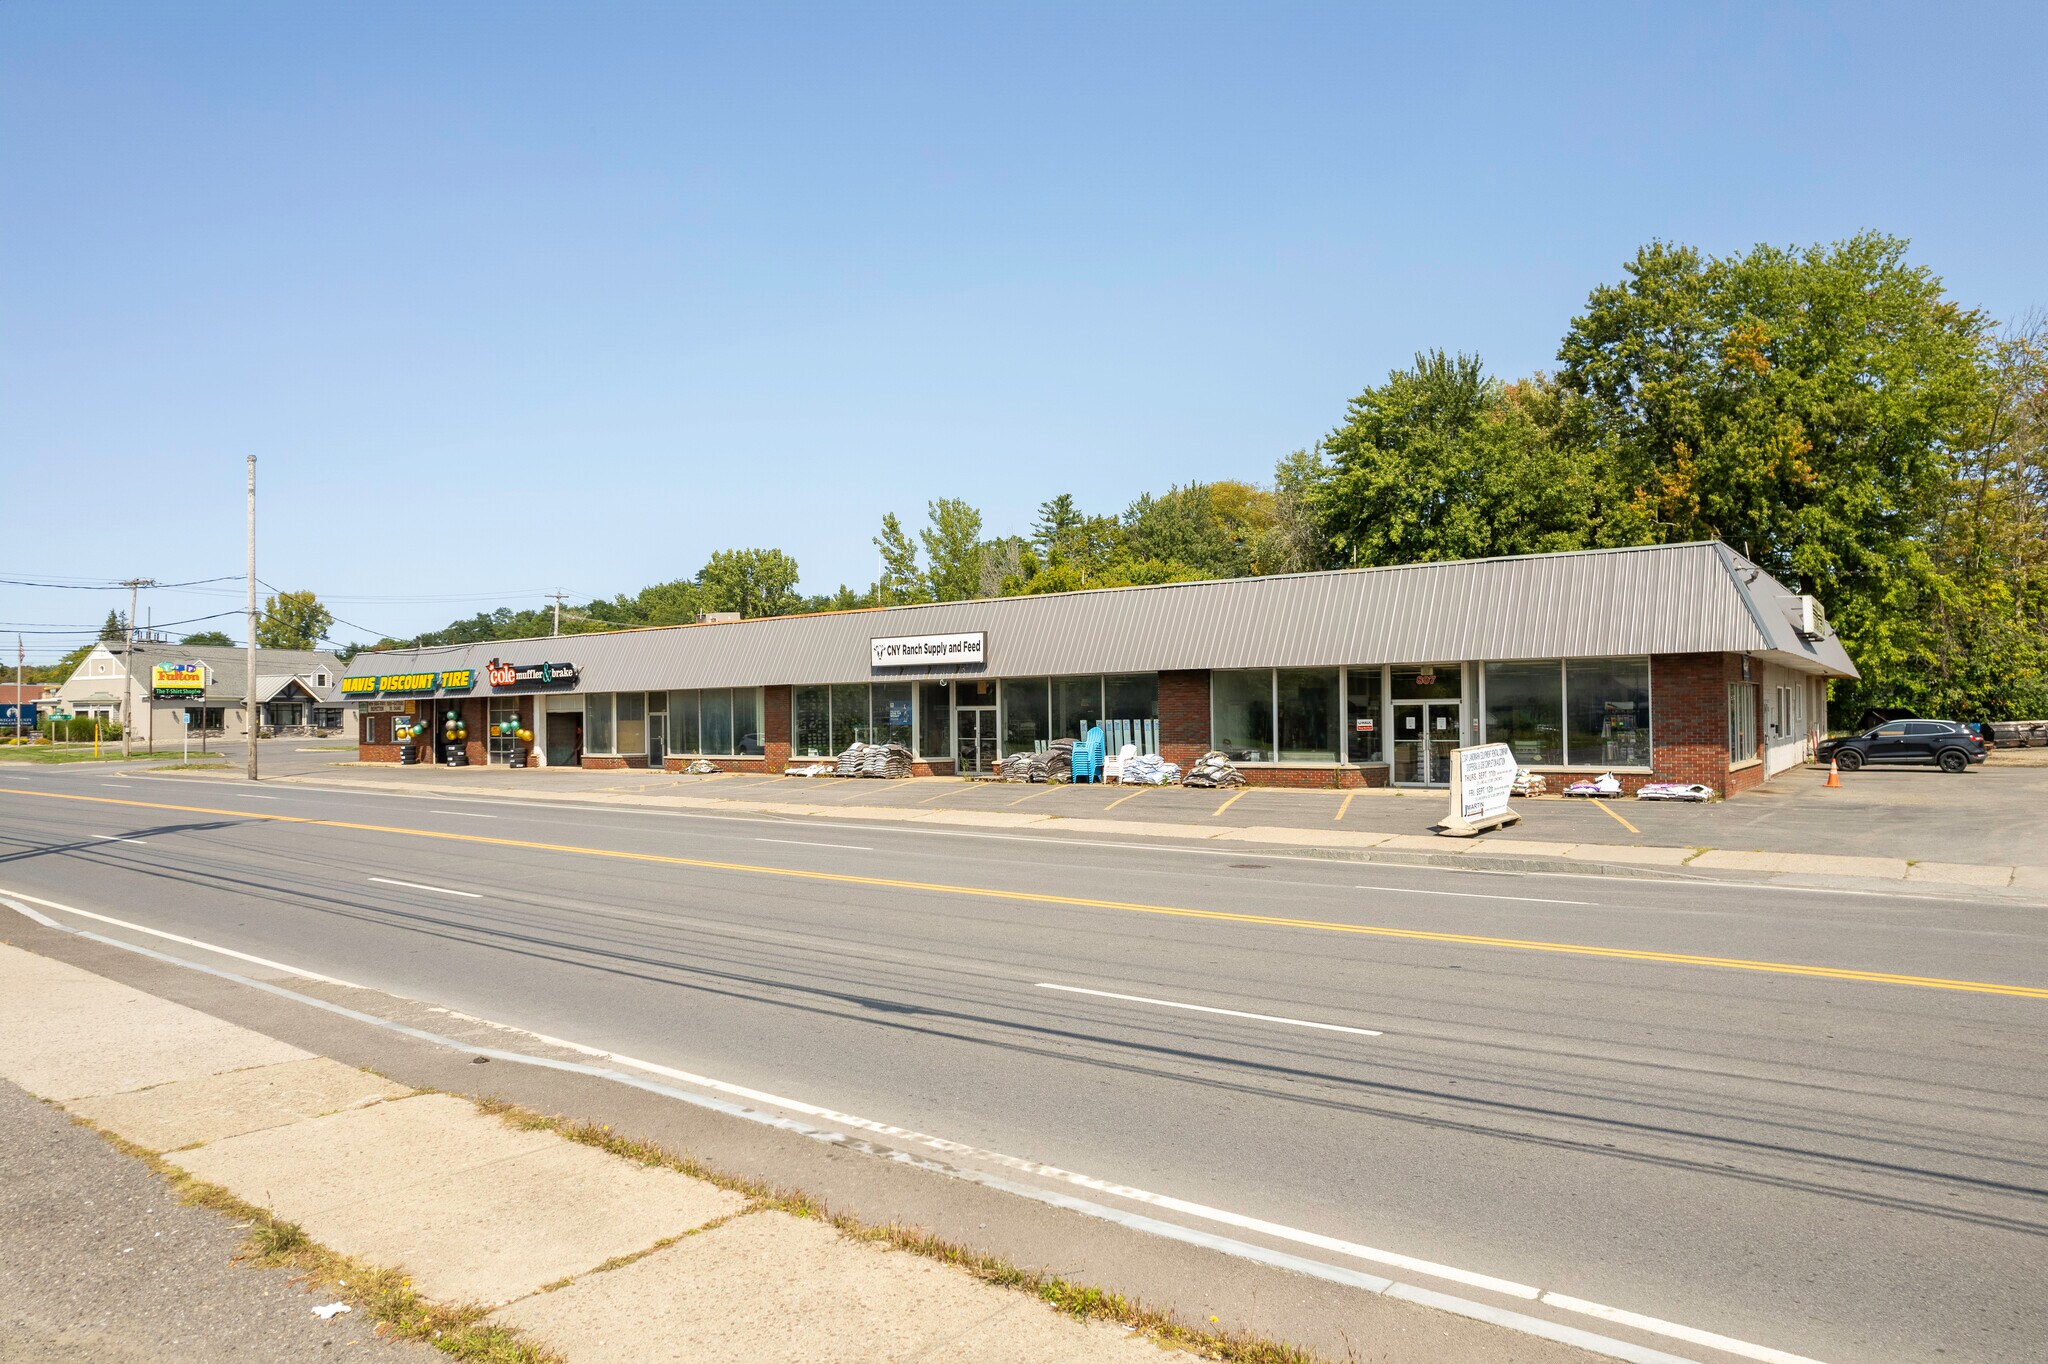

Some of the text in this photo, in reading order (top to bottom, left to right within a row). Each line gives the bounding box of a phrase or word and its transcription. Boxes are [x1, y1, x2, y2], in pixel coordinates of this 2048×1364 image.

[887, 640, 981, 656] CNY Ranch Supply and Feed
[158, 671, 200, 681] Fulton
[490, 662, 573, 684] cole muffler & brake
[342, 670, 470, 693] MAVIS DISCOUNT TIRE
[1466, 802, 1484, 811] MARTIN
